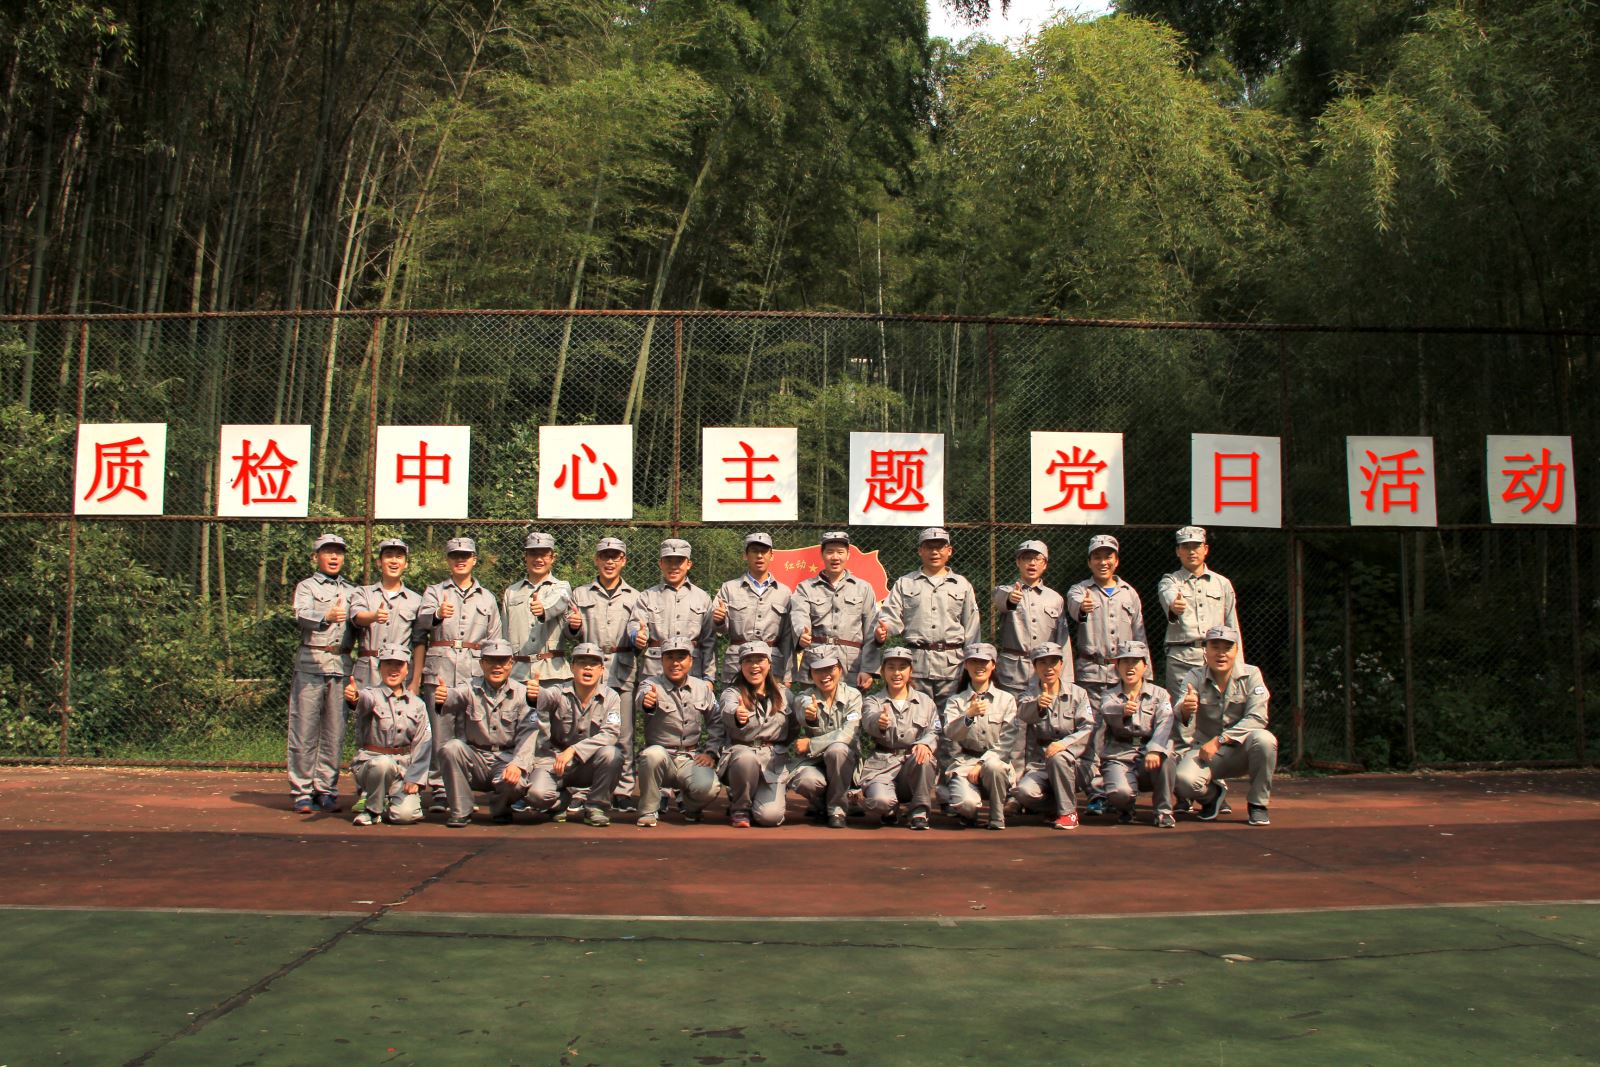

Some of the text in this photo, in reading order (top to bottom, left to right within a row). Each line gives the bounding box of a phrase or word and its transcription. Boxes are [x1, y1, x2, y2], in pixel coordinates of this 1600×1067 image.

[83, 437, 1564, 512] 质 检 中 心 主 题 党 日 活 动
